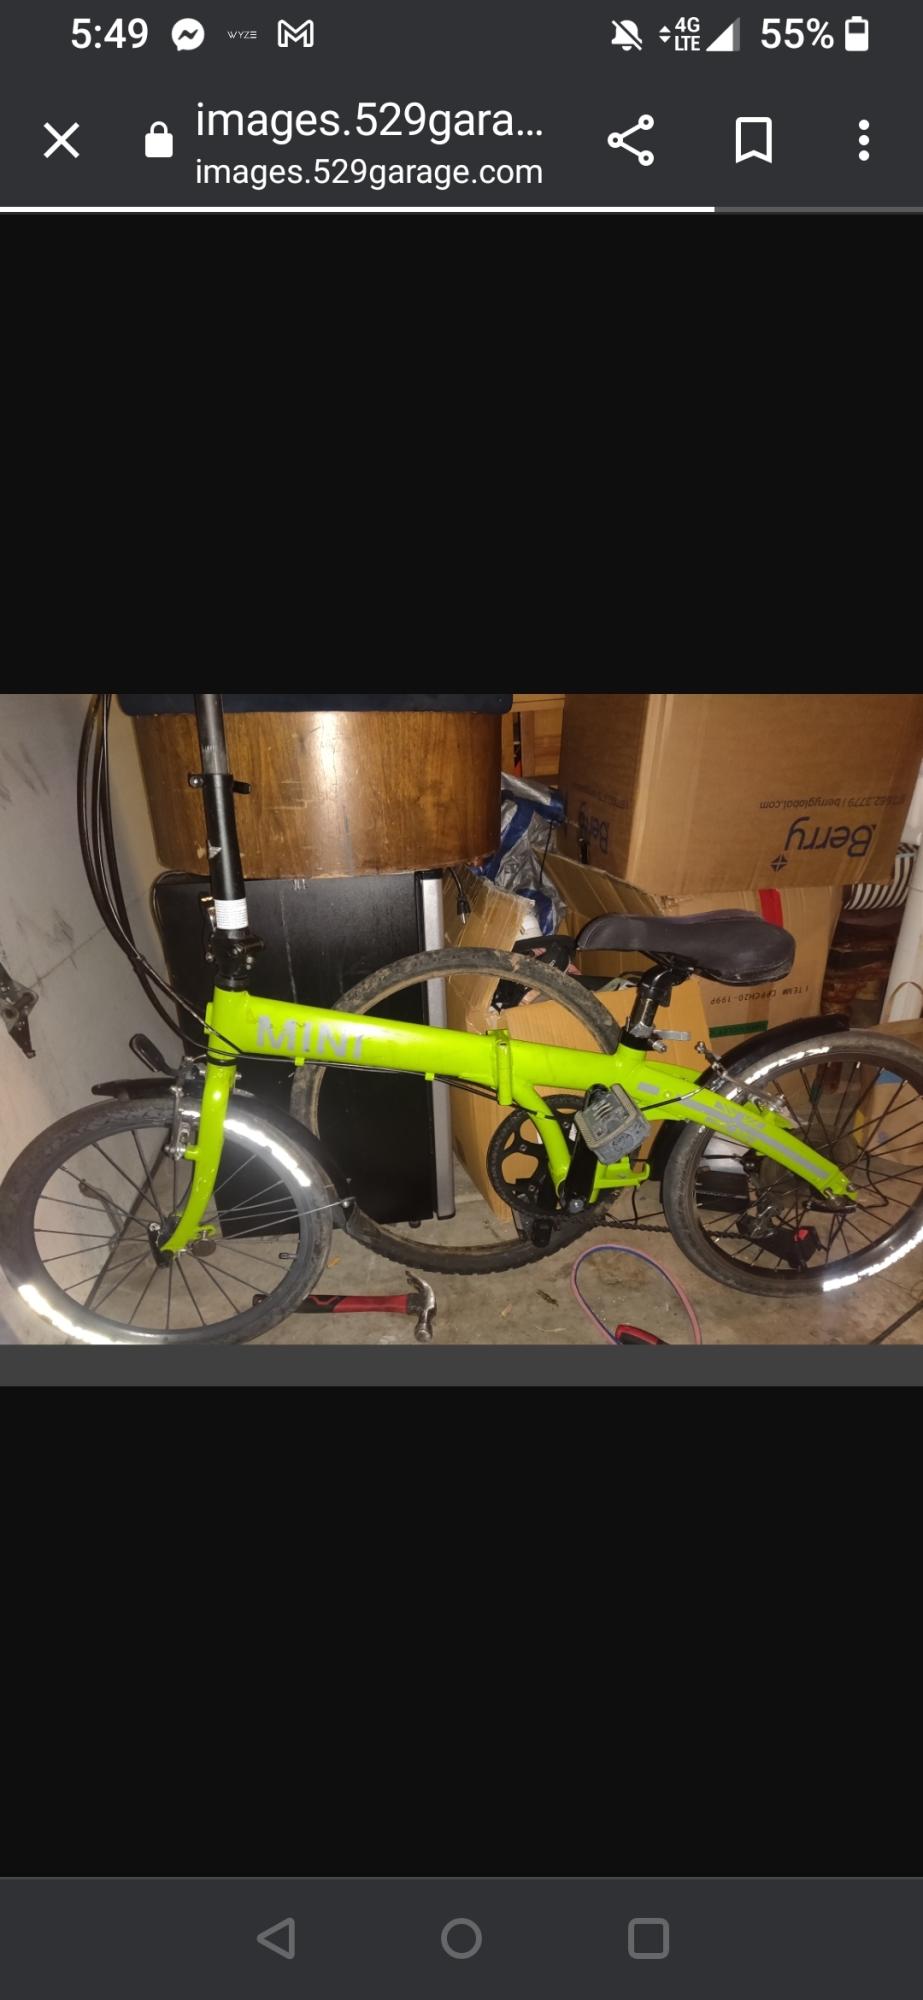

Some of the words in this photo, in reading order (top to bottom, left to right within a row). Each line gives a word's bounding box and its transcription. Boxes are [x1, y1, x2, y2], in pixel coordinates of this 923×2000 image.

[71, 17, 149, 49] 5:49
[226, 30, 257, 40] WYZE
[674, 17, 700, 33] 4G
[760, 17, 834, 49] 55%
[674, 35, 700, 51] LTE
[197, 102, 543, 145] images.529gara...
[196, 158, 543, 190] images.529garage.com
[760, 796, 840, 809] berryglobal.com
[784, 816, 876, 857] Berry
[257, 1015, 363, 1060] MINI
